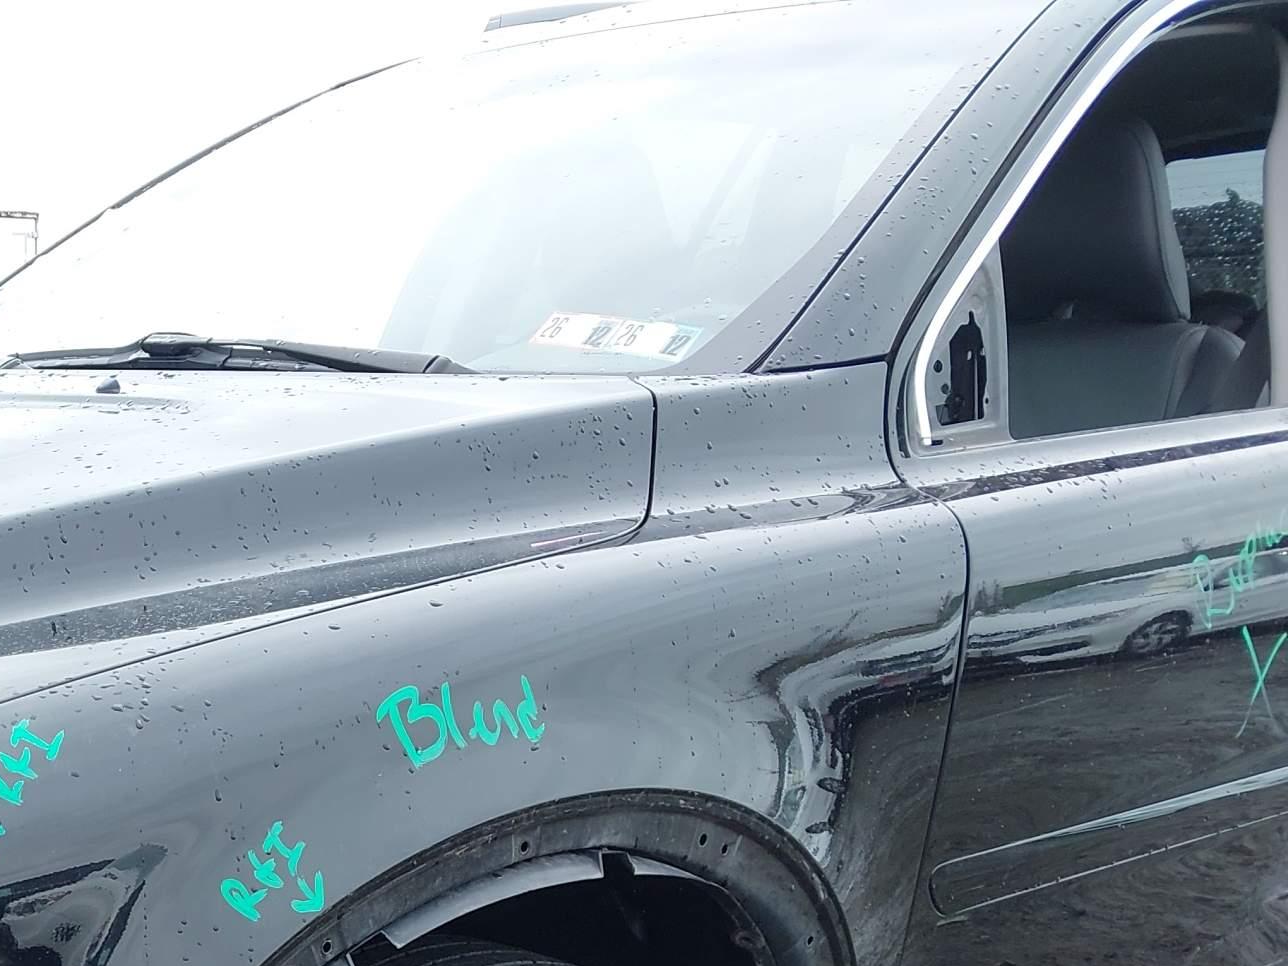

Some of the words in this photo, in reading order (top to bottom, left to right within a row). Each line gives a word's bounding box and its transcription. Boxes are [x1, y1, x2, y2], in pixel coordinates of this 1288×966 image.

[539, 316, 570, 339] 26
[582, 325, 612, 348] 12
[616, 324, 645, 347] 26
[658, 333, 693, 357] 12
